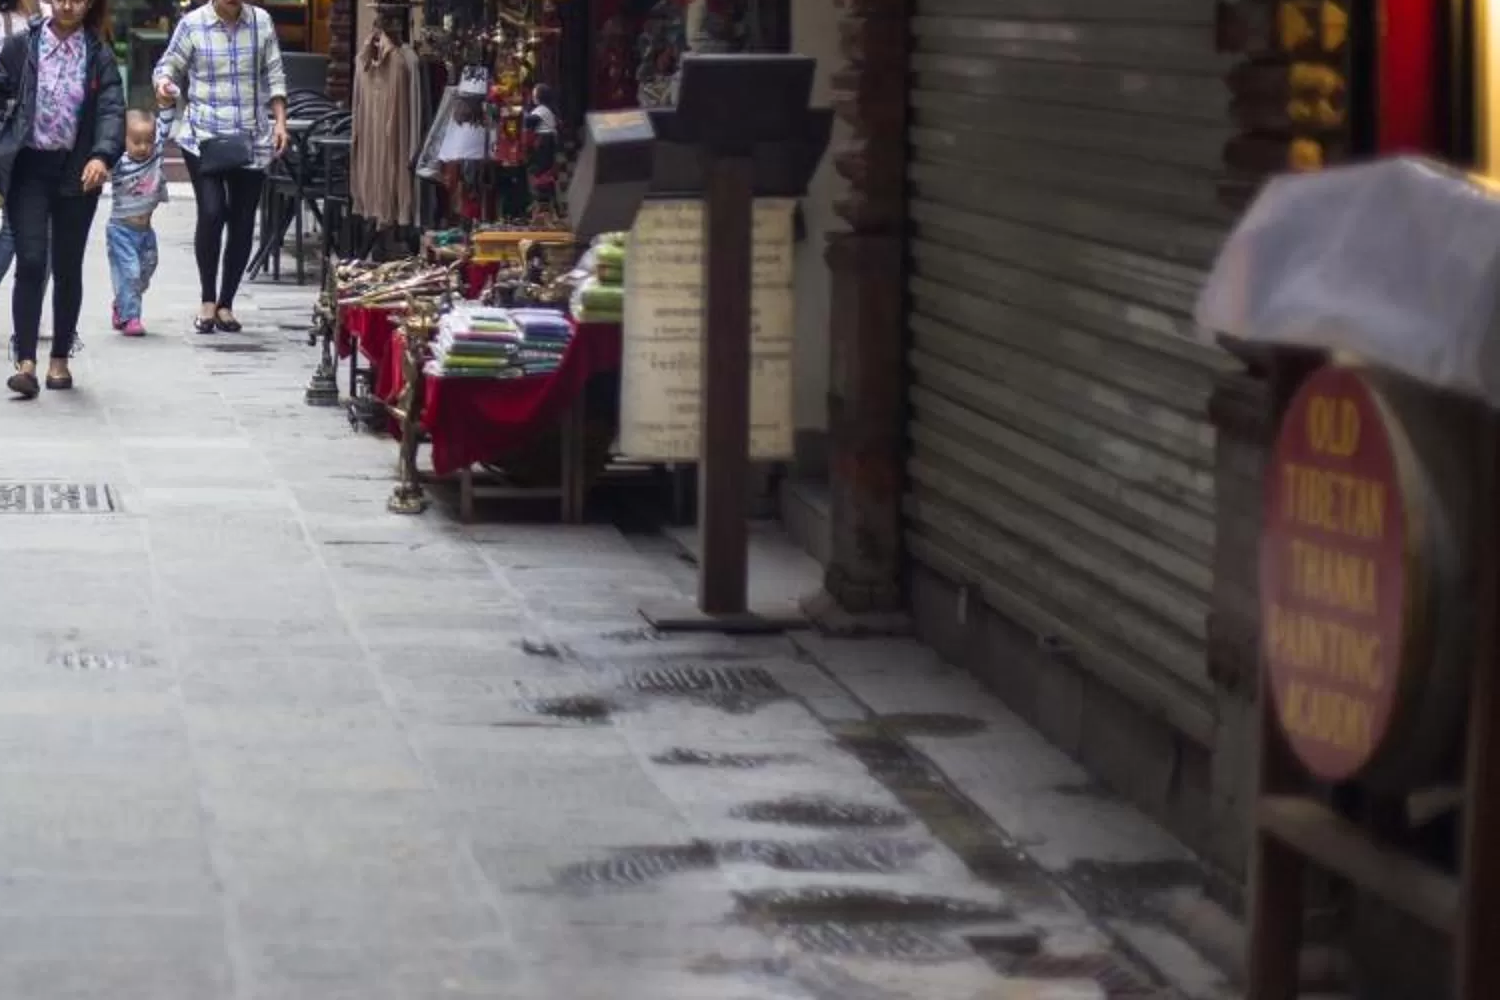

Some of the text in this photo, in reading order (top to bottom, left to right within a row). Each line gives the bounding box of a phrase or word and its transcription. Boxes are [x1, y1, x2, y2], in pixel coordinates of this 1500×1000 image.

[1307, 395, 1361, 456] OLD
[1283, 463, 1385, 538] TIBETAN
[1268, 602, 1382, 691] PAINTING
